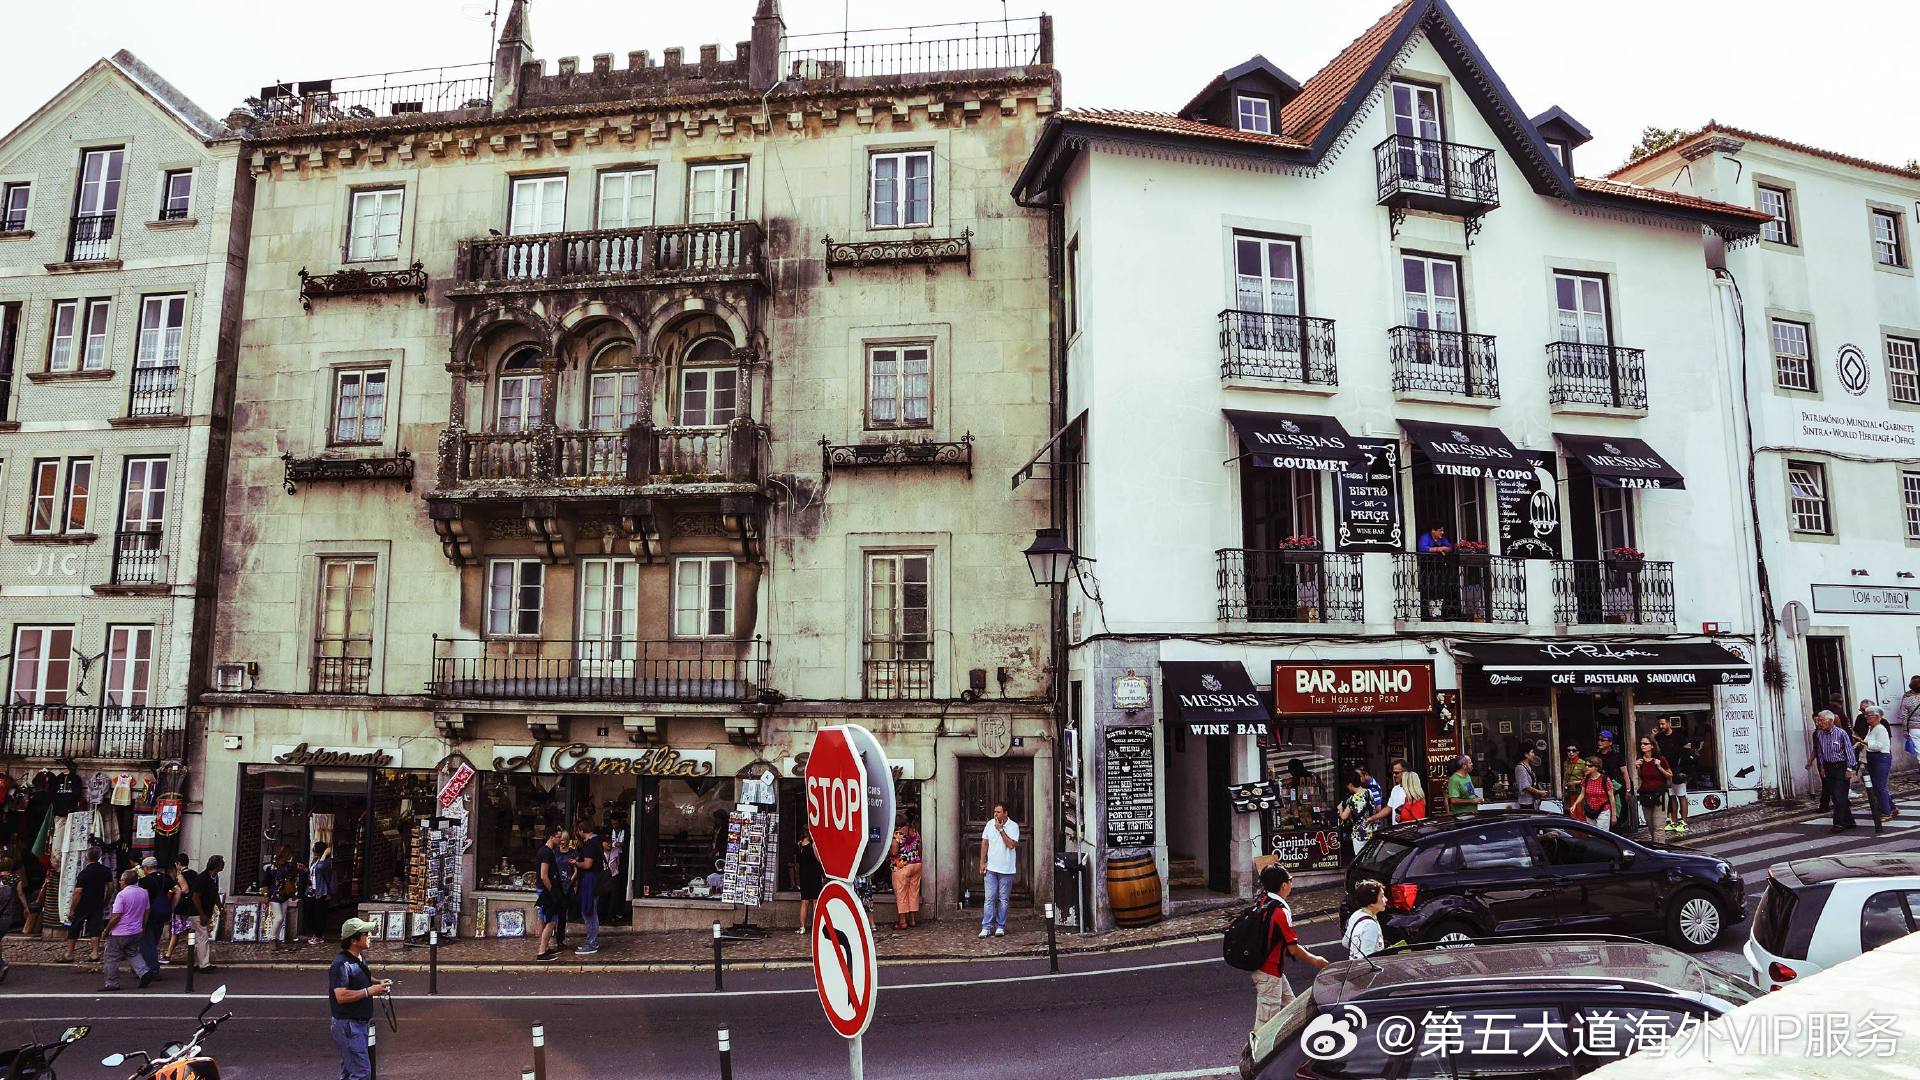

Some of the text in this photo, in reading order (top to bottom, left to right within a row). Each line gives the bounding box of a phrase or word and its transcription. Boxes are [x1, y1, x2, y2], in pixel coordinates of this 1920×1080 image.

[1801, 411, 1915, 433] PATRIMÓNIO MUNDIAL GABINETE
[1254, 431, 1346, 450] MESSIAS
[1802, 425, 1916, 446] SINTRA WORLD HERITAGE OFFICE
[1430, 441, 1513, 459] MESSIAS
[1272, 456, 1350, 472] GOURMET
[1586, 454, 1662, 469] MESSIAS
[1435, 464, 1533, 480] VINHO A COPO
[1619, 477, 1661, 489] TAPAS
[1348, 485, 1388, 496] BISTRÔ
[1350, 510, 1389, 522] PRAÇA
[1356, 527, 1372, 535] WINE
[27, 553, 79, 576] JIC
[1852, 590, 1871, 604] LOJA
[1295, 669, 1412, 694] BAR do BINHO
[1551, 672, 1697, 684] CAFÉ PASTELARIA SANDWICH
[1179, 693, 1259, 707] MESSIAS
[1310, 695, 1326, 704] THE
[1331, 694, 1358, 704] HOUSE
[1379, 694, 1399, 703] PORT
[1190, 723, 1268, 736] WINE BAR
[1734, 743, 1750, 754] TAPAS
[492, 741, 713, 777] A Camélia
[807, 775, 861, 832] STOP
[1108, 811, 1133, 819] PORTO
[1126, 820, 1154, 831] TASTING
[1271, 832, 1317, 851] Ginjinha
